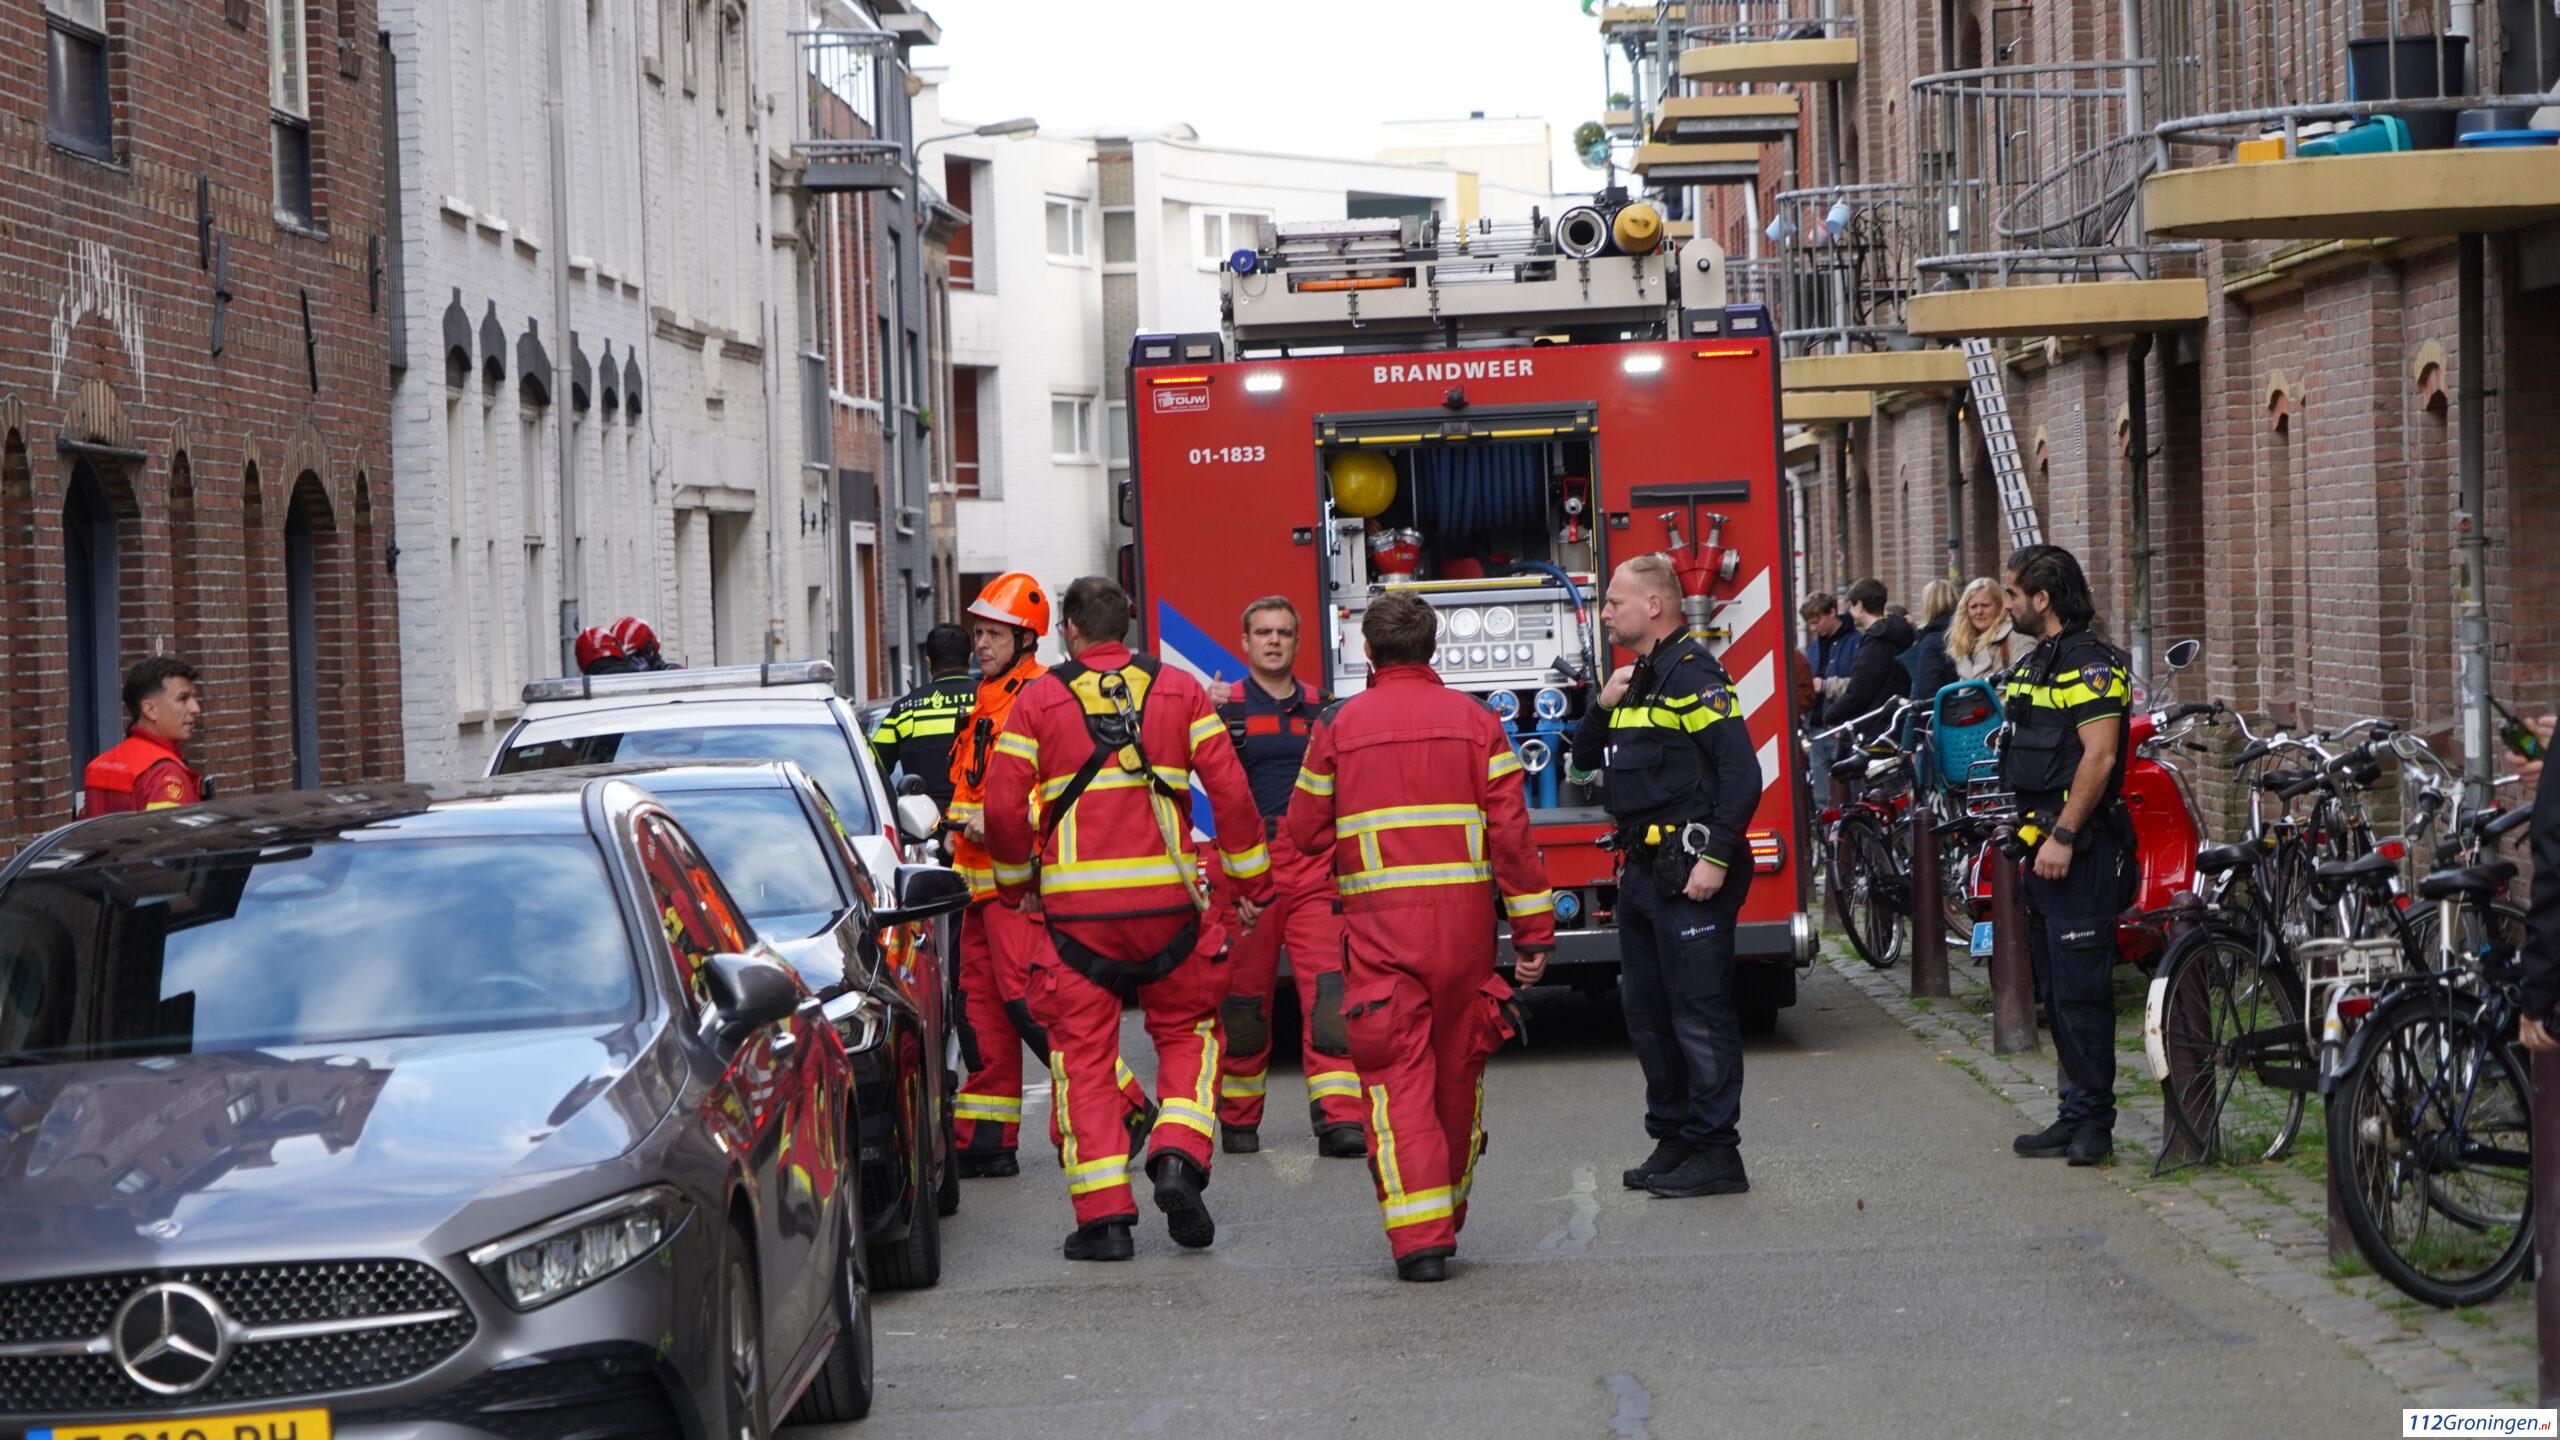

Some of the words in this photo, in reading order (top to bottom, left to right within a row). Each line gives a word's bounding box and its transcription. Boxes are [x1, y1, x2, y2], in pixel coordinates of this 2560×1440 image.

[1373, 358, 1534, 384] BRANDWEER
[1189, 445, 1266, 465] 01-1833
[923, 690, 975, 709] POLITI
